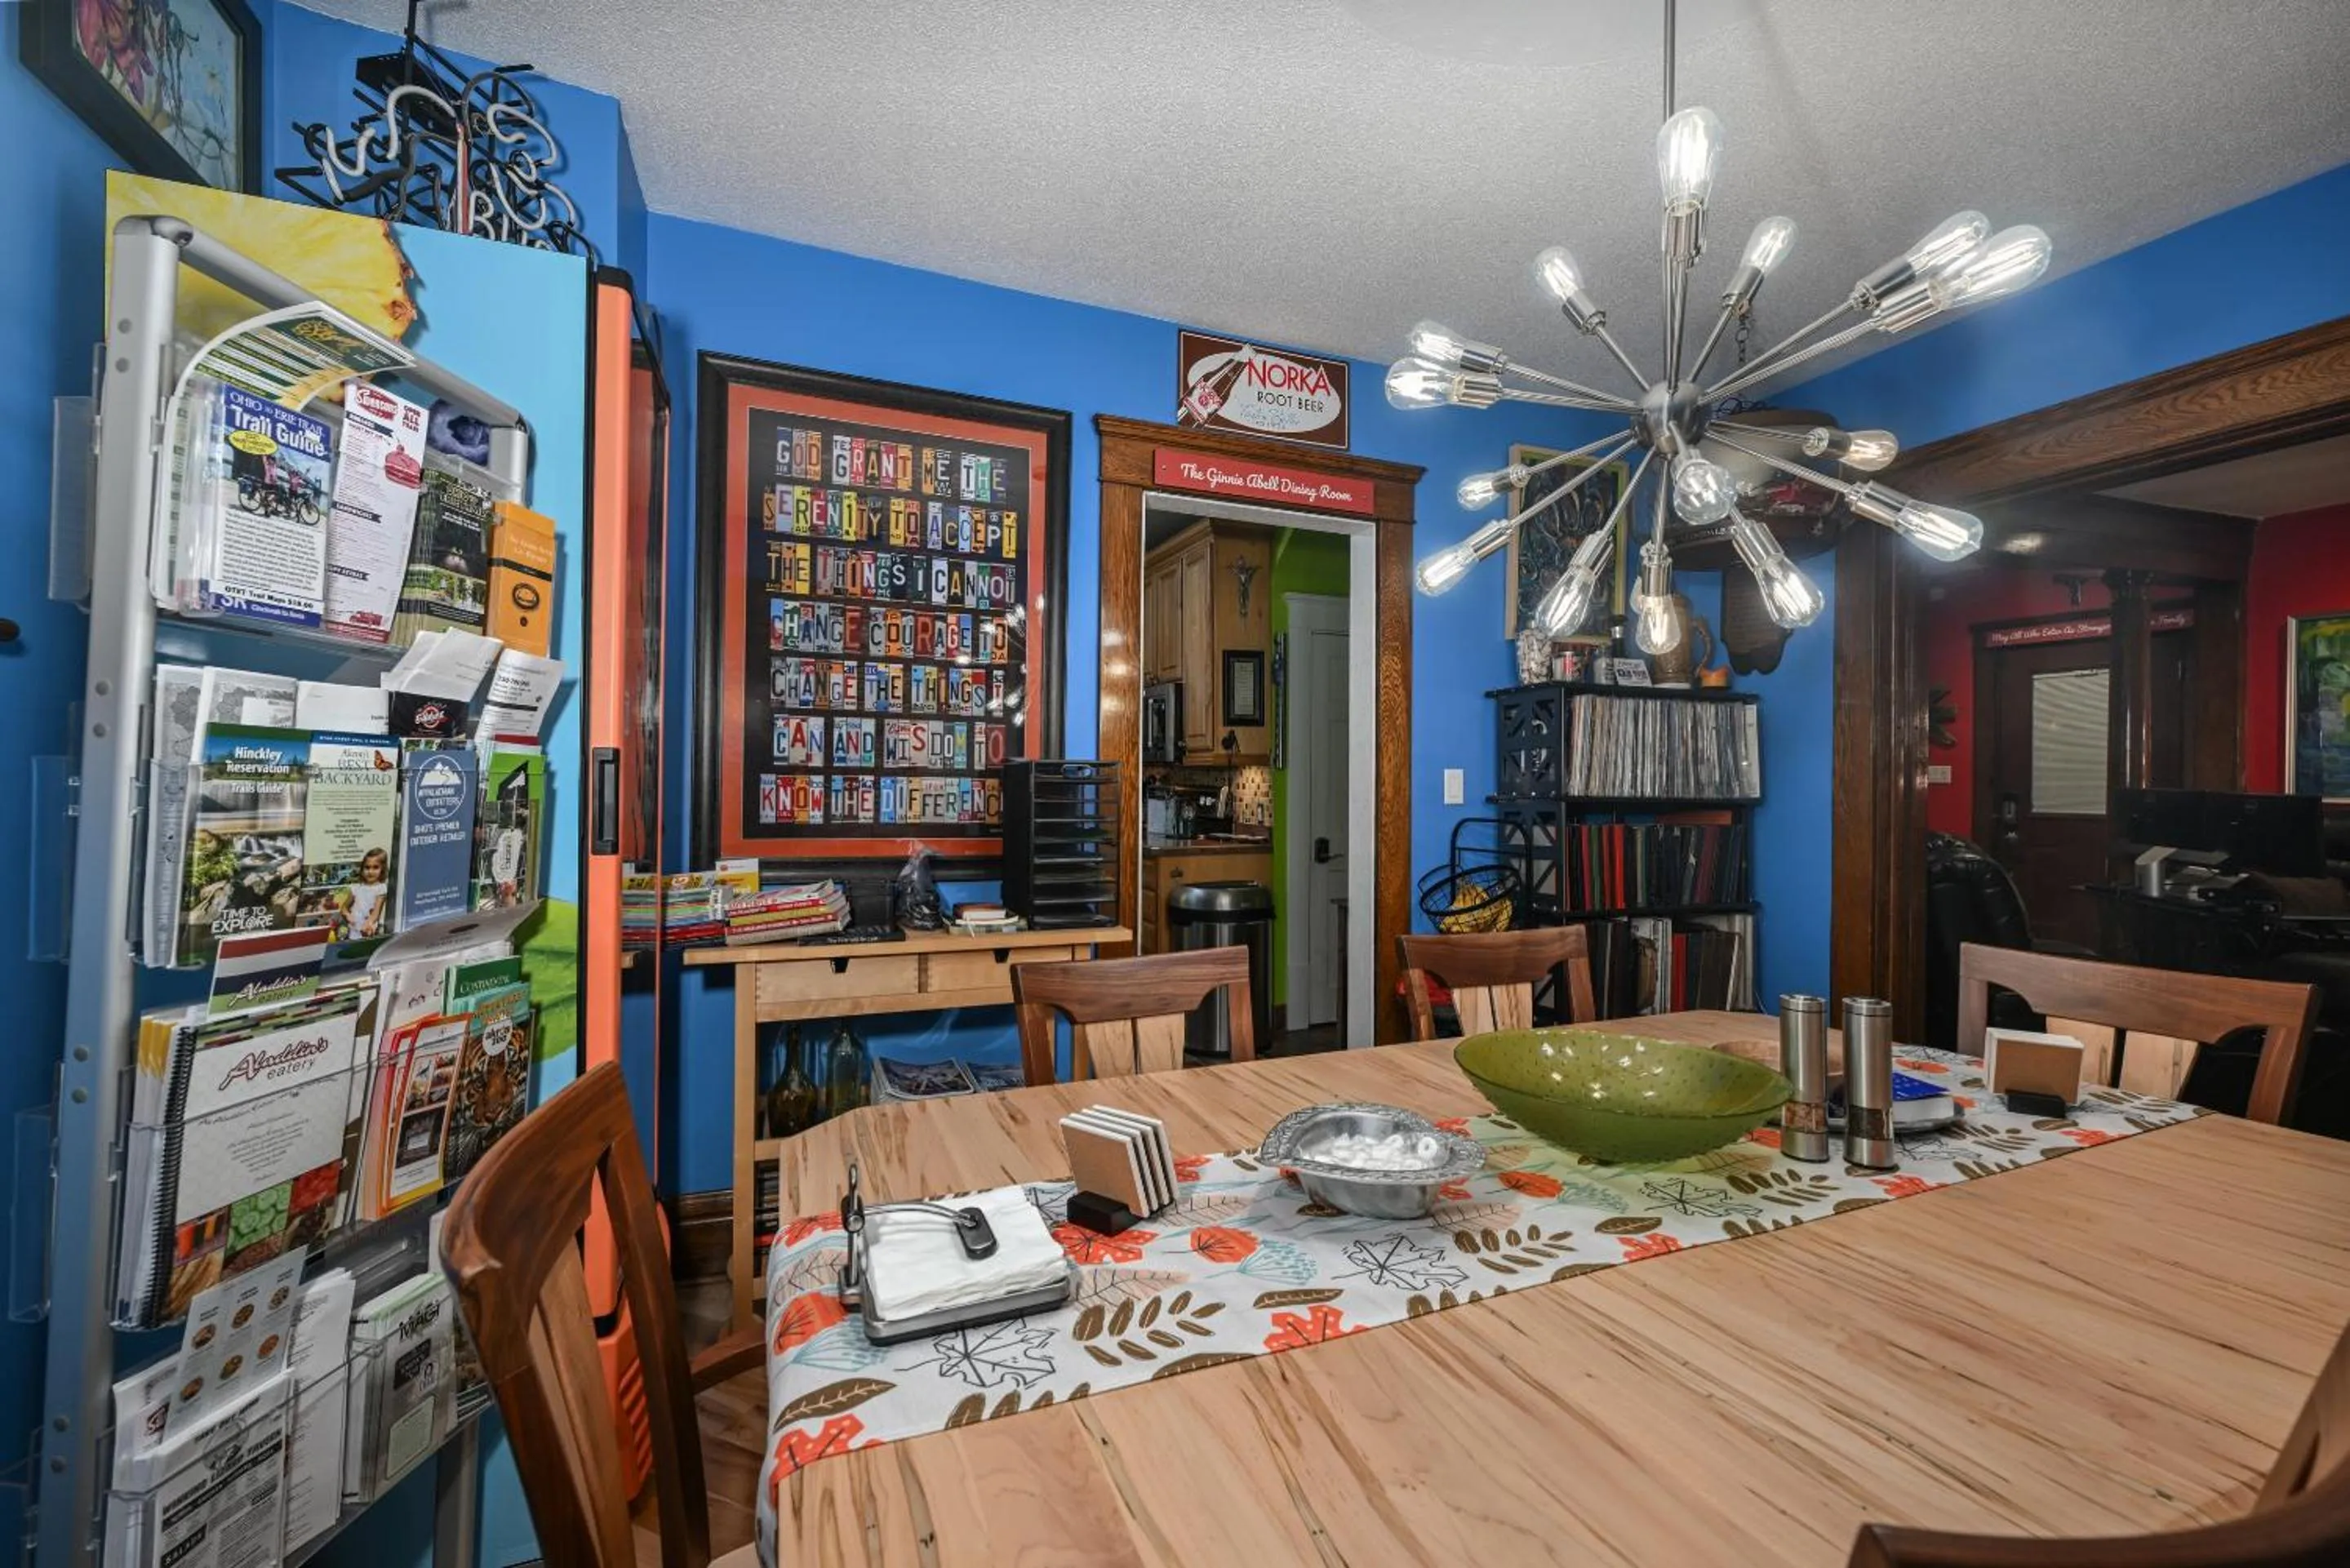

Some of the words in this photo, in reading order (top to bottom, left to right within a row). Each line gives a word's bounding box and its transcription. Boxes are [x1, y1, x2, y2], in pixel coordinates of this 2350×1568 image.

[1246, 357, 1330, 397] NORKA
[230, 392, 262, 411] OHIO
[274, 408, 297, 425] ERIE
[298, 417, 325, 438] TRAIL
[1257, 391, 1292, 408] ROOT
[1298, 397, 1325, 413] BEER
[230, 404, 272, 438] Trail
[275, 423, 327, 457] Guide
[776, 440, 820, 475] GOD
[834, 450, 911, 480] GRANT
[924, 460, 949, 487] ME
[963, 463, 1006, 491] THE
[1181, 463, 1206, 480] The
[1207, 468, 1245, 488] Ginnie
[1247, 474, 1279, 491] Abell
[1282, 478, 1317, 501] Dining
[1320, 485, 1353, 502] Room
[764, 486, 882, 536] SERENITY
[891, 509, 918, 533] TO
[930, 516, 1015, 549] ACCEPT
[767, 552, 809, 583] THE
[819, 549, 906, 595] THINGS
[933, 567, 1015, 602] CANNOT
[771, 606, 860, 650] CHANGE
[871, 612, 971, 652] COURAGE
[982, 616, 1008, 651] TO
[771, 668, 855, 701] CHANGE
[866, 675, 903, 702] THE
[913, 677, 986, 708] THINGS
[234, 746, 282, 762] Hinckley
[776, 722, 824, 754] CAN
[834, 731, 873, 755] AND
[886, 726, 966, 759] WISDOM
[975, 730, 1005, 764] TO
[225, 759, 289, 774] Reservation
[313, 771, 392, 786] BACKYARD
[231, 783, 255, 793] Trails
[258, 784, 283, 793] Guide
[762, 786, 824, 813] KNOW
[831, 788, 874, 816] THE
[211, 914, 274, 933] EXPLORE
[223, 908, 248, 920] TIME
[252, 906, 267, 916] TO
[229, 975, 306, 1007] Aladdin's
[219, 1037, 328, 1090] Aladdin's
[267, 1058, 316, 1080] eatery
